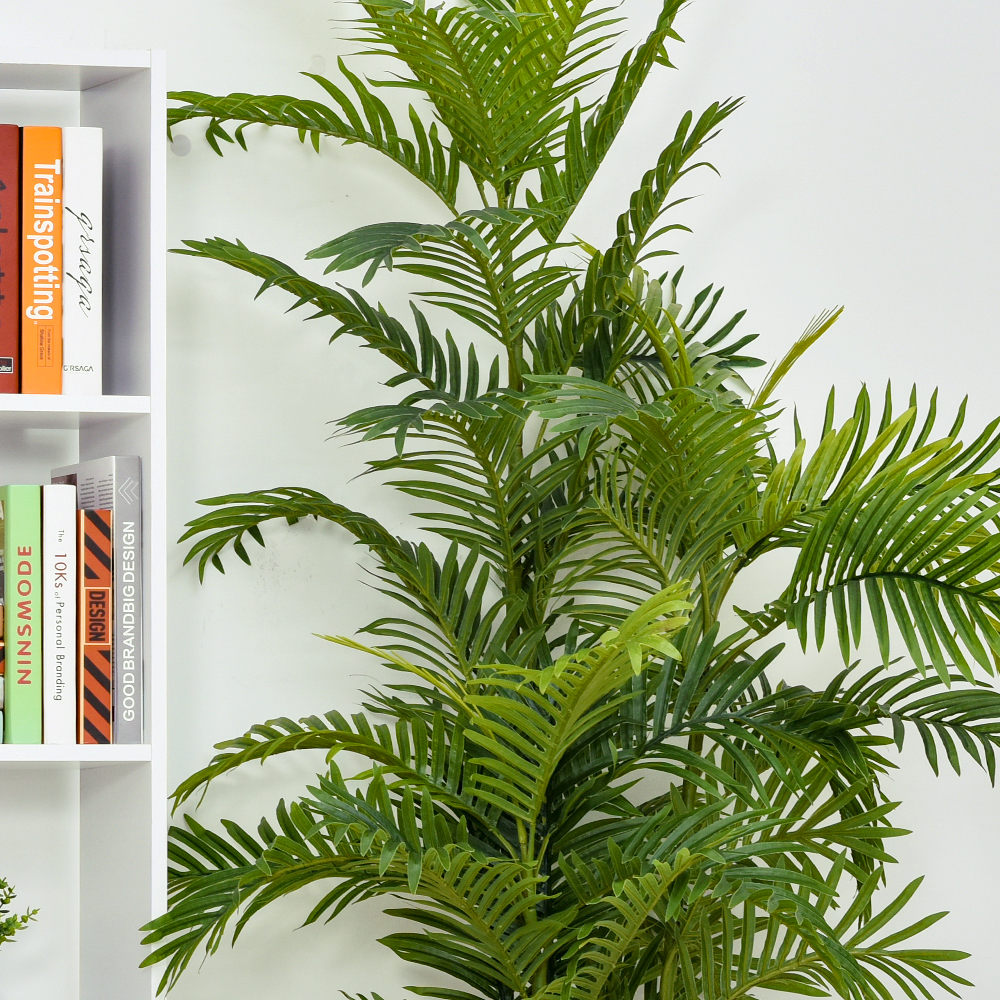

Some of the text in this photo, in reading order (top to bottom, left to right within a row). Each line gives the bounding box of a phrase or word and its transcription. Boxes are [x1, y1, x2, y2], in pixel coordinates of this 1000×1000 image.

[26, 159, 60, 320] Trainspotting
[54, 553, 67, 588] 10Ks
[17, 546, 32, 684] NINSMODE
[54, 592, 60, 600] of
[89, 590, 106, 642] DESIGN
[55, 602, 65, 649] Personal
[53, 655, 65, 701] Branding
